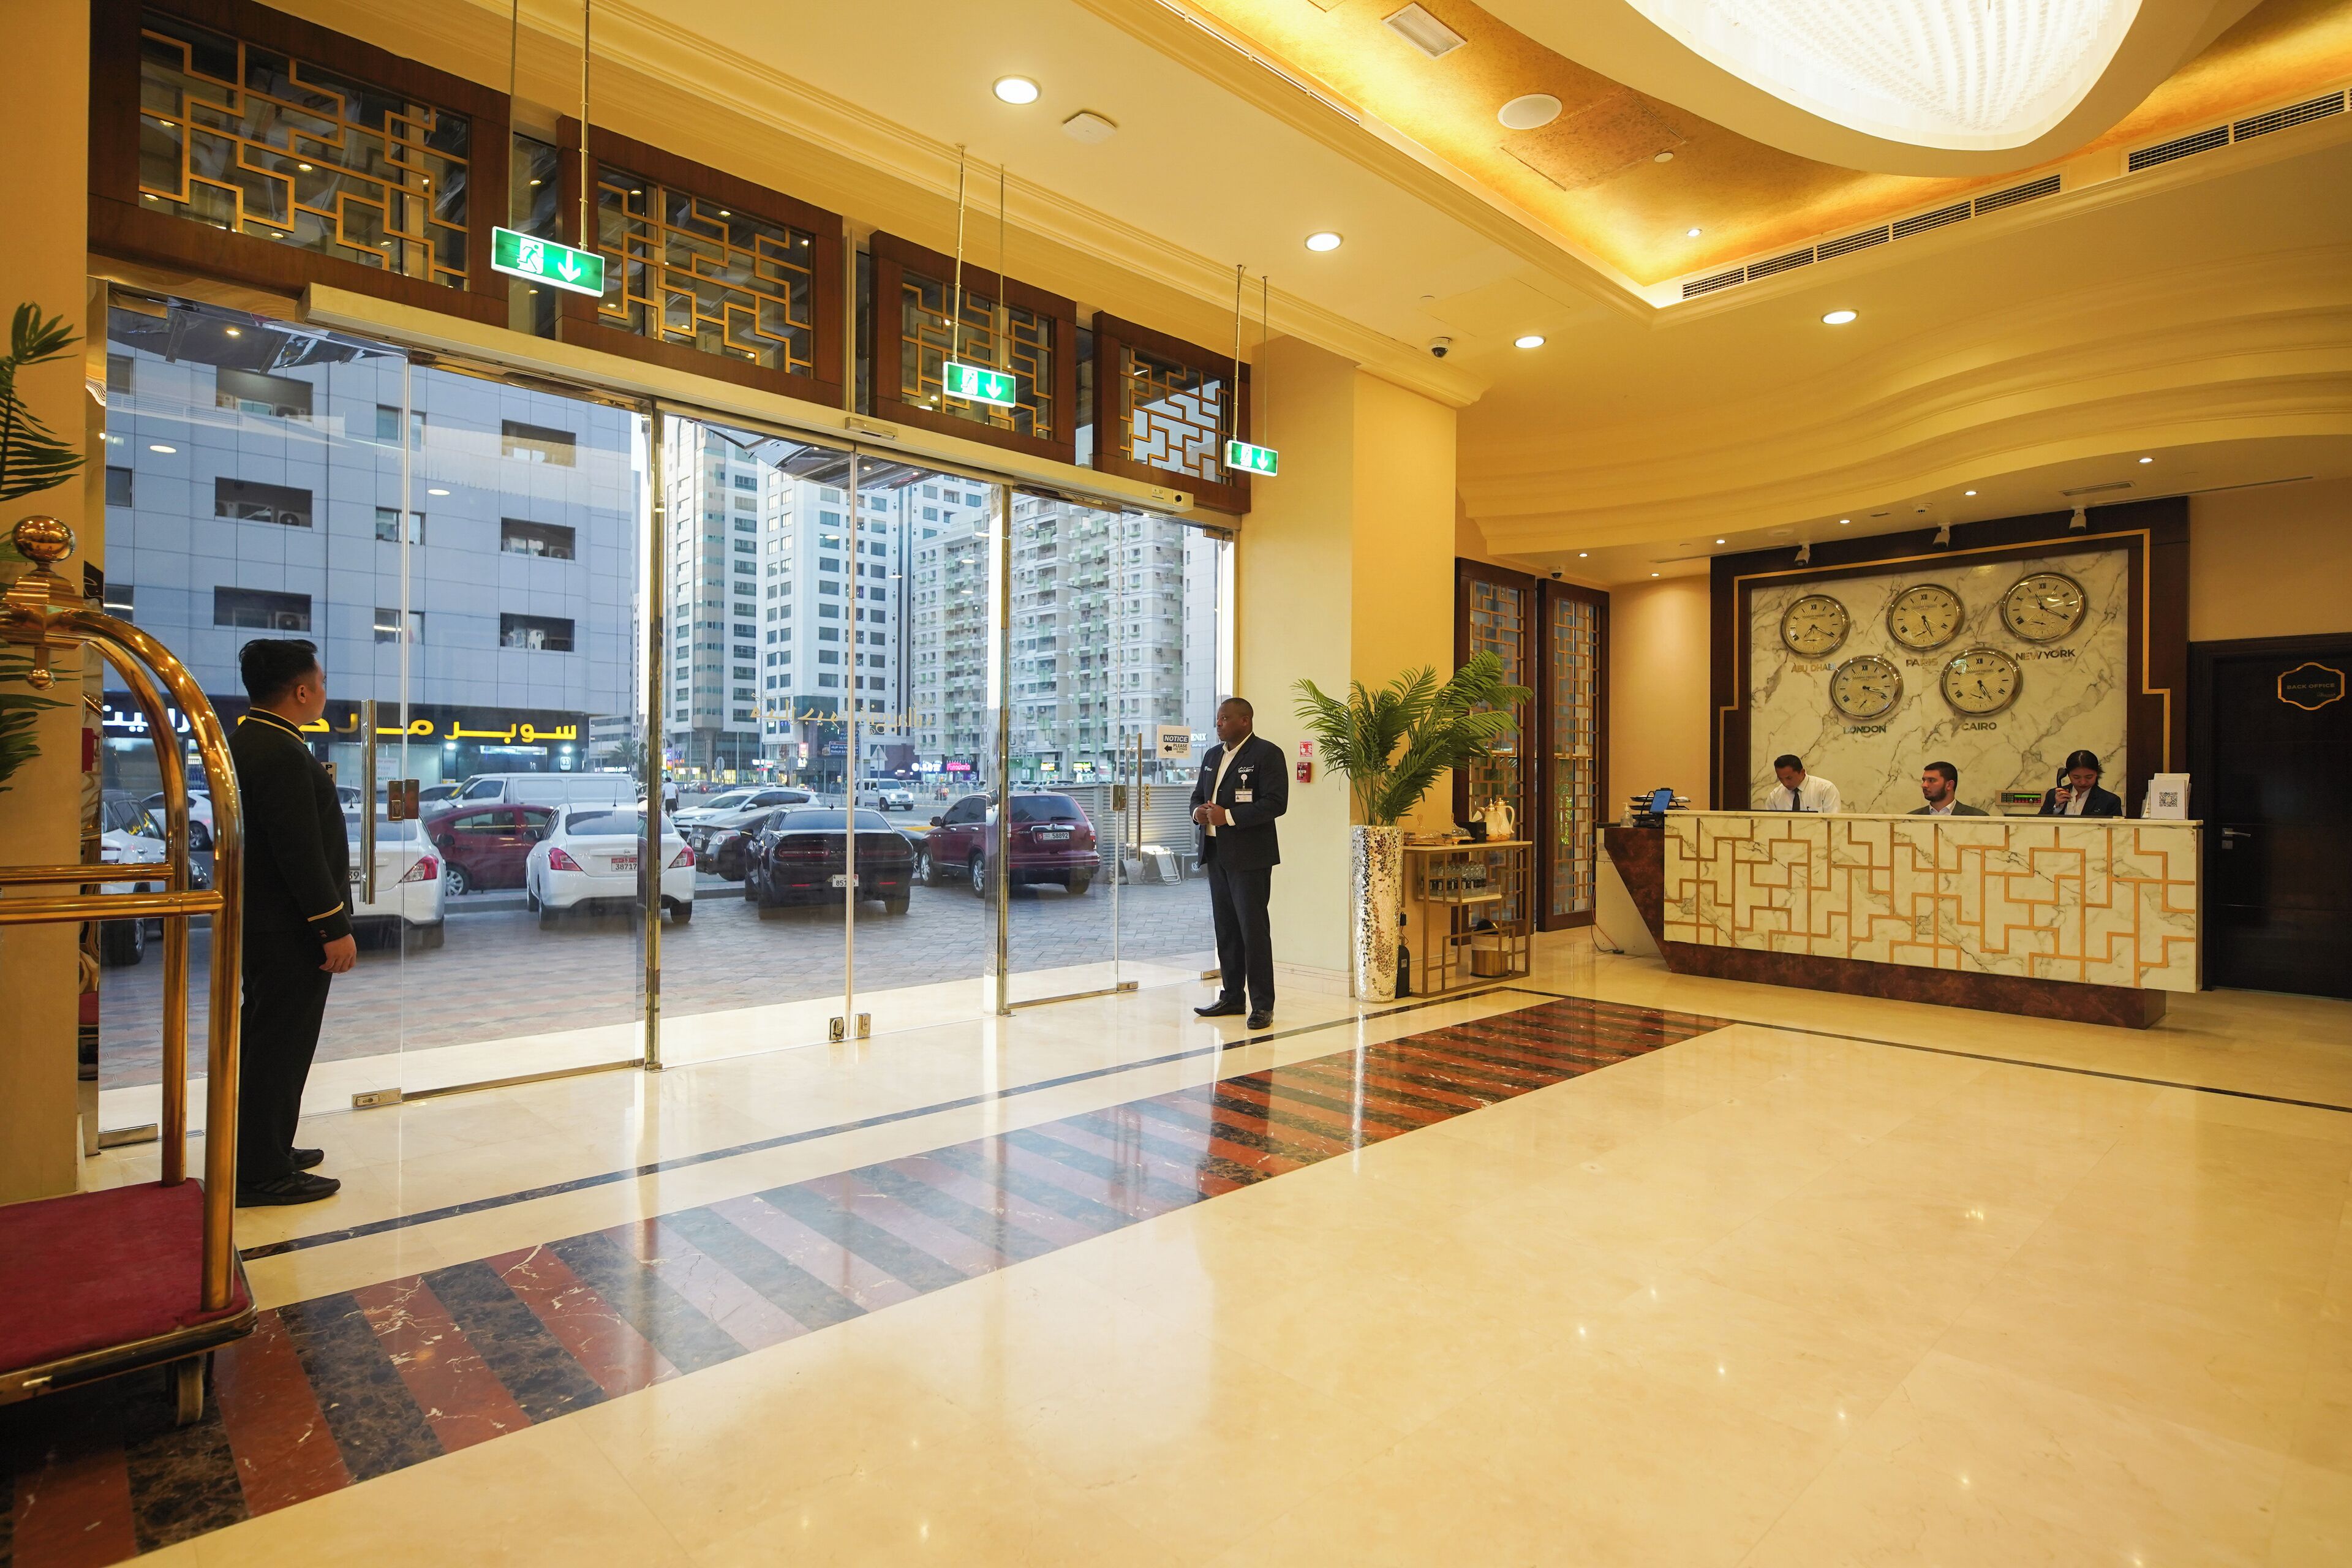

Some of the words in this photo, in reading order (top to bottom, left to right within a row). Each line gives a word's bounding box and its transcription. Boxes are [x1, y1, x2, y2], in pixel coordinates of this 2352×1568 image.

[2015, 651, 2043, 661] NEW
[2043, 649, 2075, 659] YORK
[1905, 658, 1938, 667] PARIS
[1810, 663, 1836, 672] DHABI
[1843, 725, 1887, 734] LONDON
[1961, 722, 1997, 731] CAIRO
